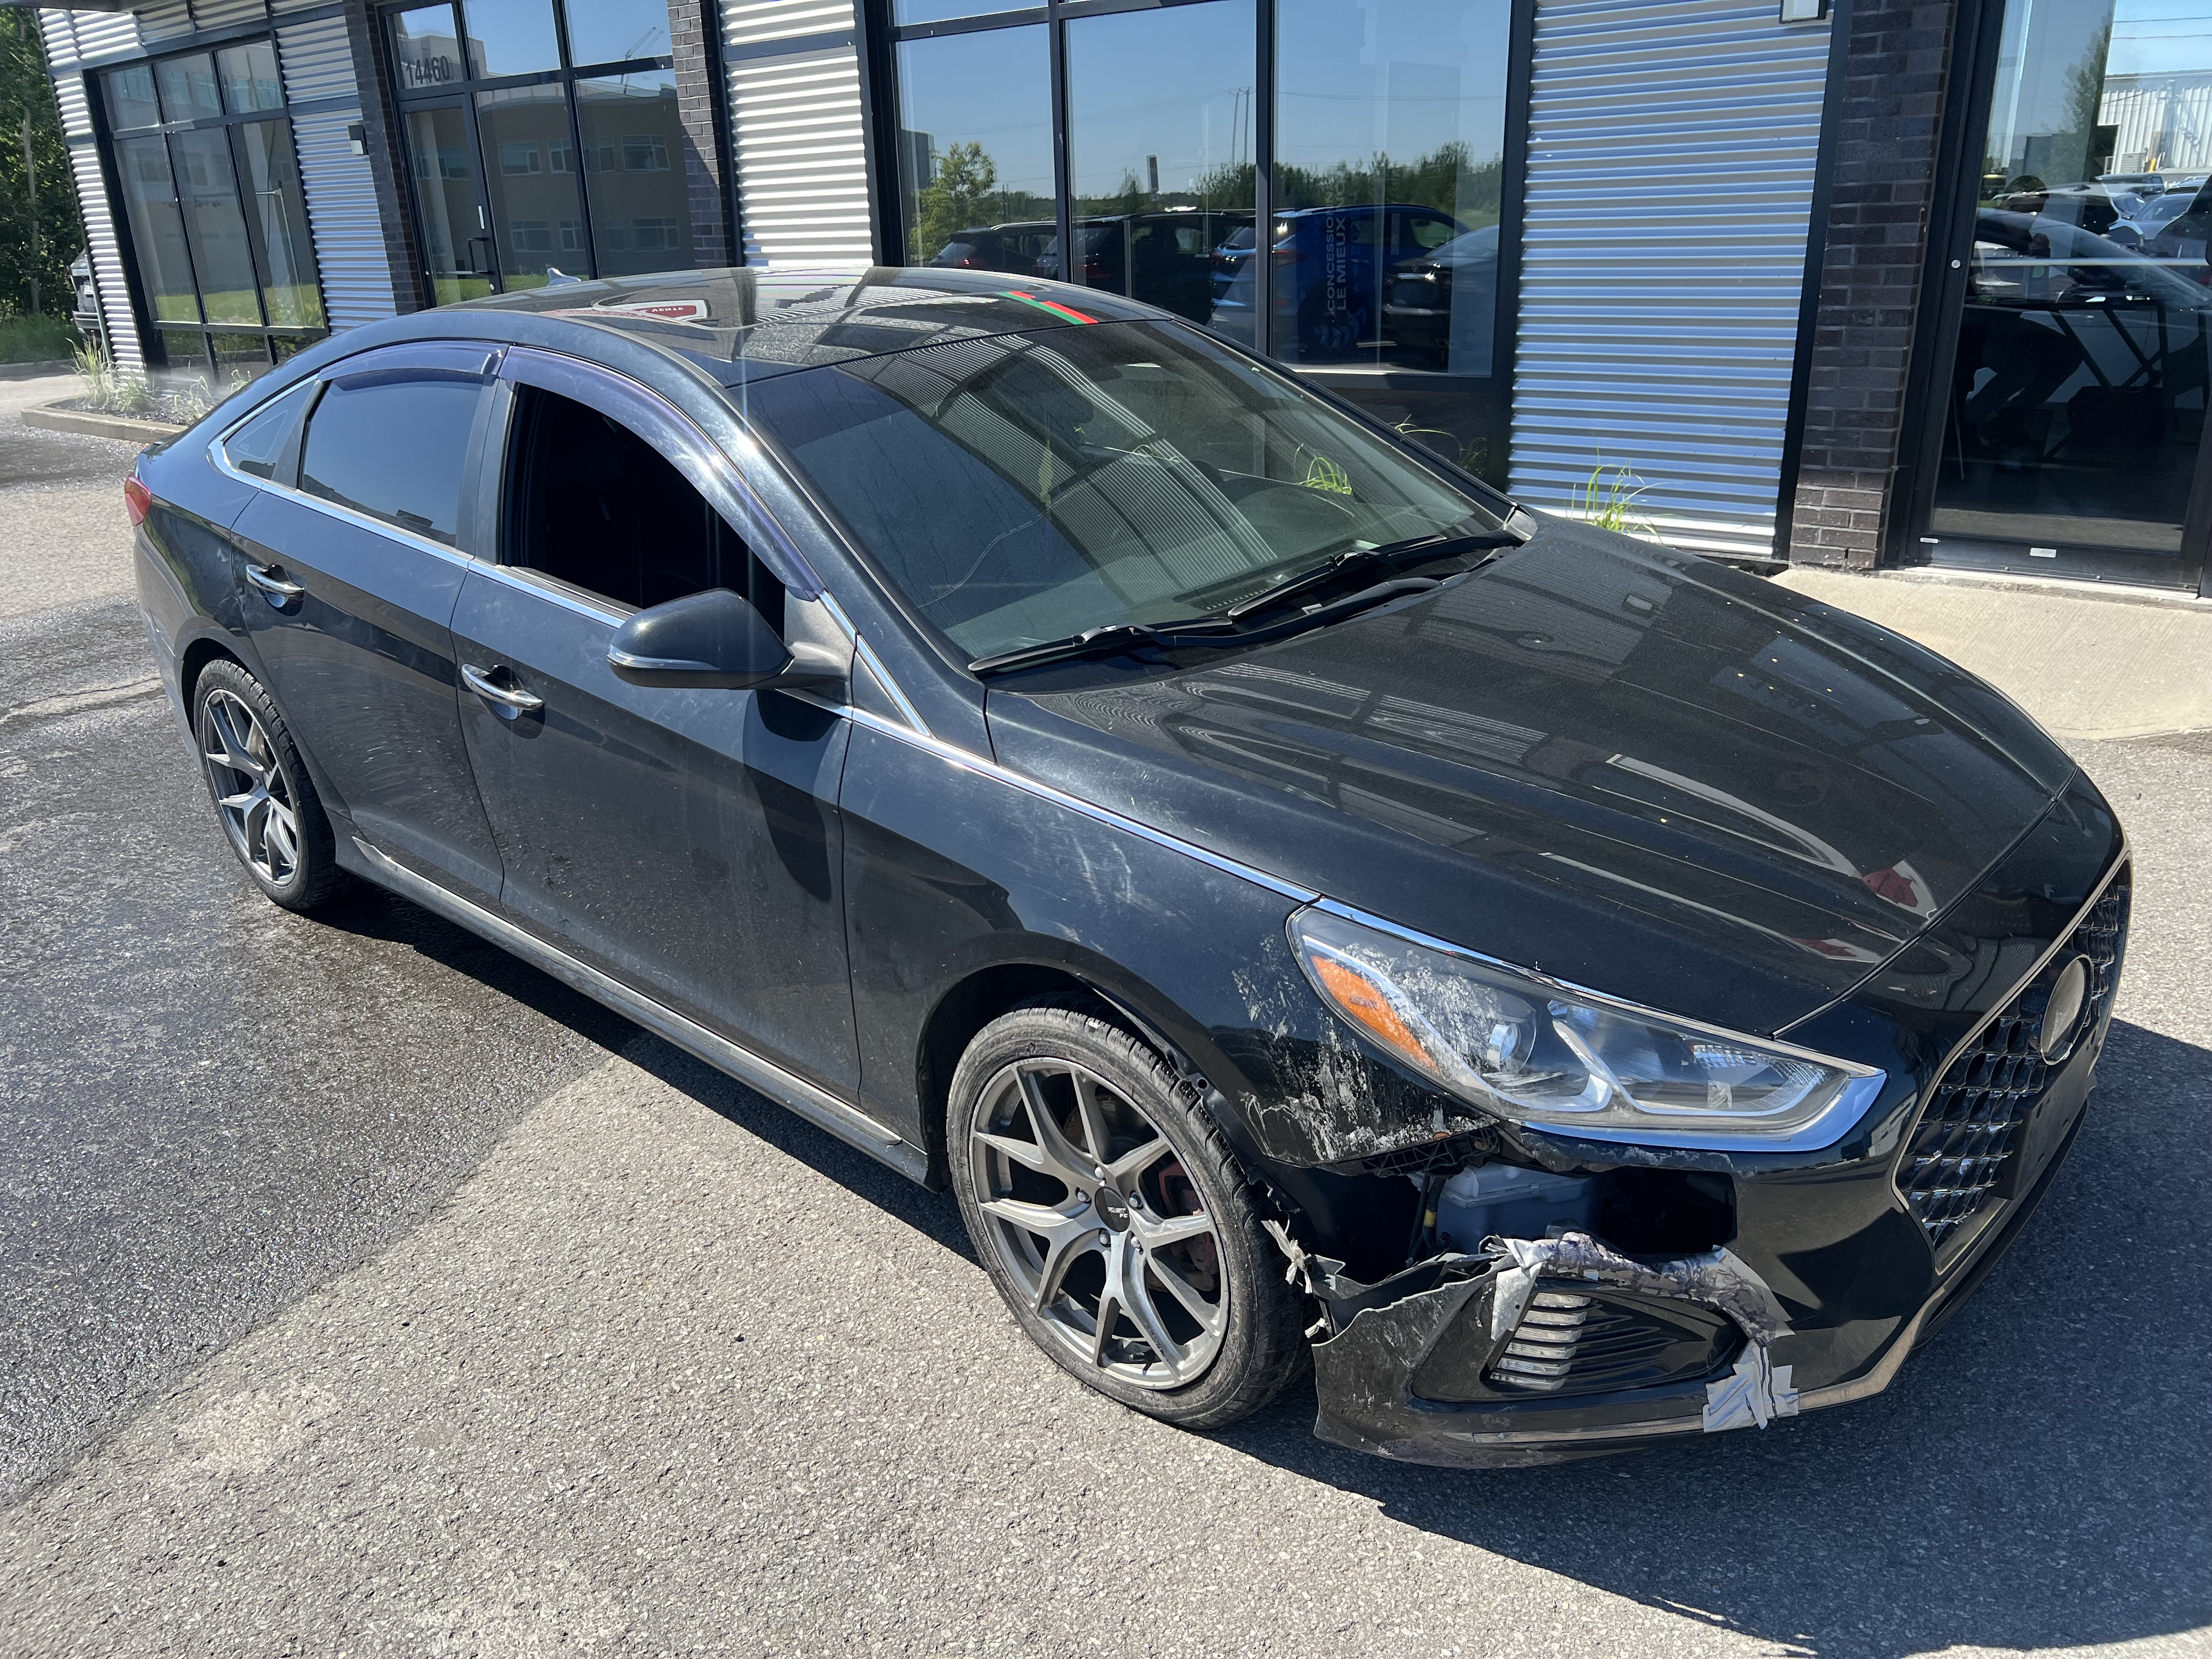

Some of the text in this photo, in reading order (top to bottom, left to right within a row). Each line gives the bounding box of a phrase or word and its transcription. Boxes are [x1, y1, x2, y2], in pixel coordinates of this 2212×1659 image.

[406, 55, 449, 86] 14460
[1336, 217, 1346, 284] MIEUX
[1336, 287, 1346, 311] LE
